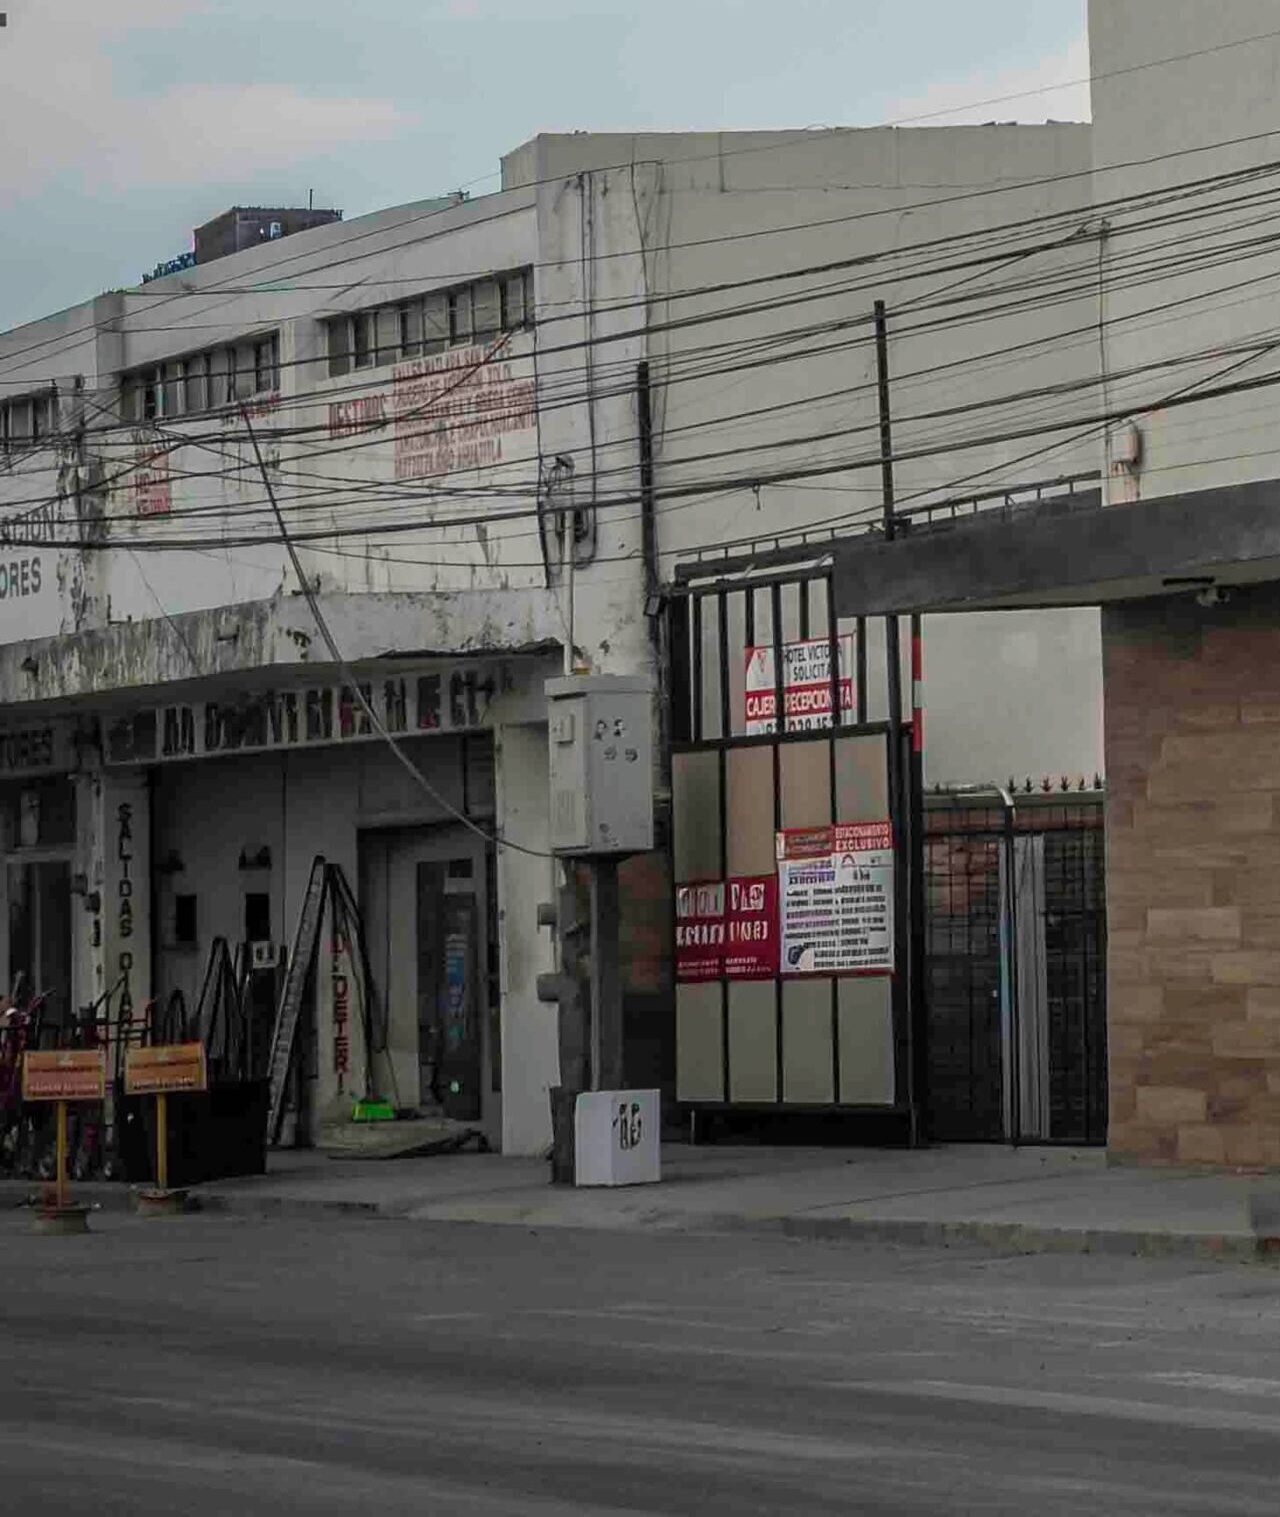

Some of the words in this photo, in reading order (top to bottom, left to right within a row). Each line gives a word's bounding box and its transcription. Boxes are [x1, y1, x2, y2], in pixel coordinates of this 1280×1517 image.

[835, 824, 889, 840] ESTACIONAMIENTO
[835, 837, 890, 853] EXCLUSIVO
[118, 802, 133, 938] SALIDAS
